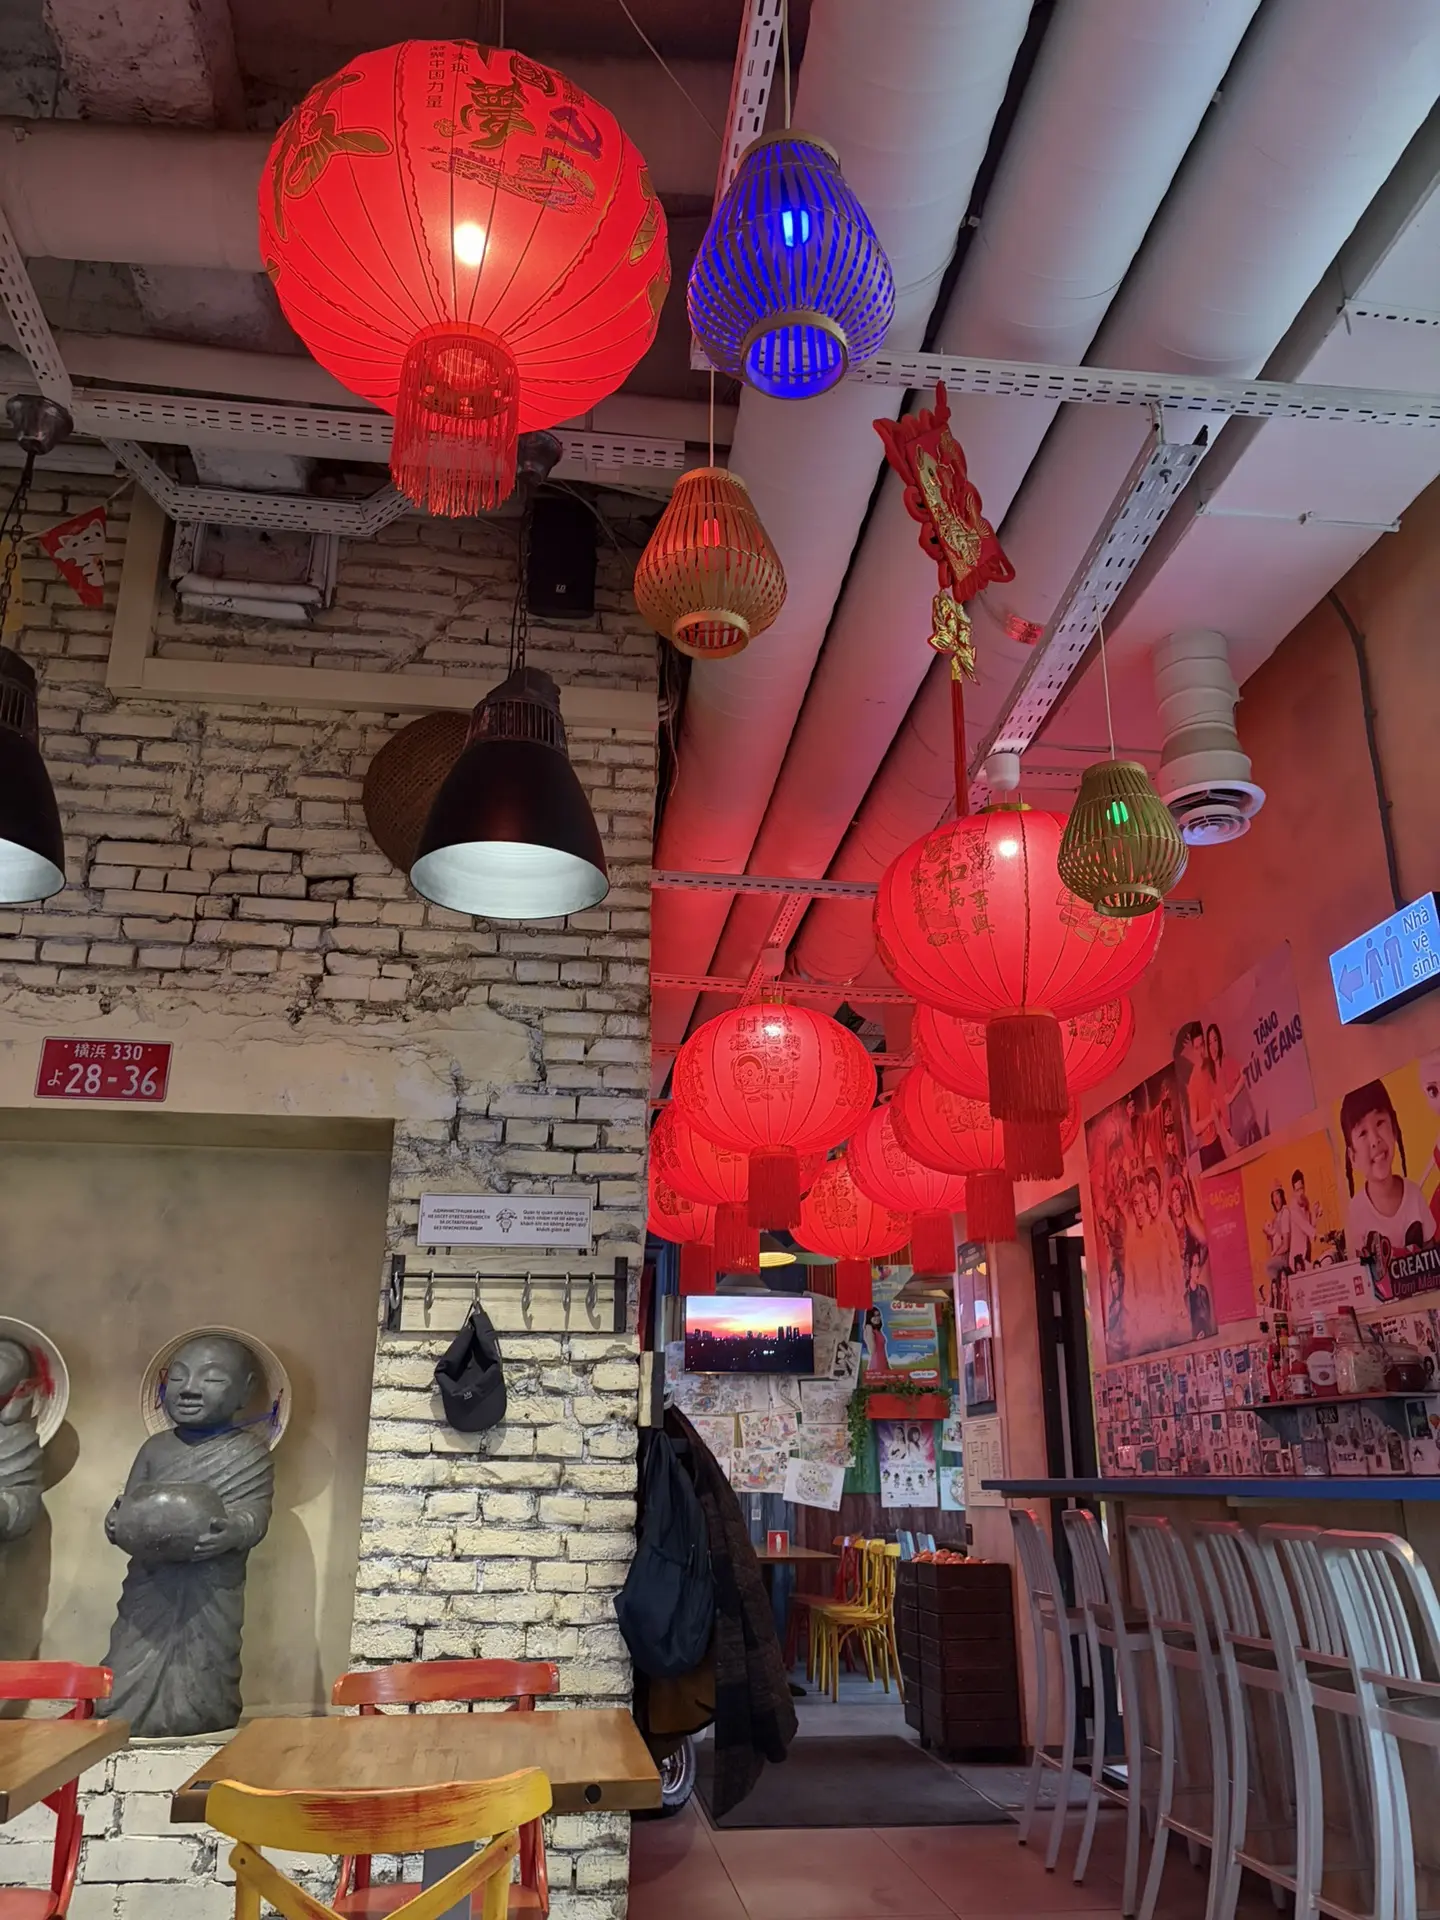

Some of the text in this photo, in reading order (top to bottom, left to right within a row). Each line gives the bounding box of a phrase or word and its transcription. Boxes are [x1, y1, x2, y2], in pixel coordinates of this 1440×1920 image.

[1402, 905, 1431, 935] Nhà
[1412, 930, 1430, 953] vệ
[1412, 950, 1440, 979] sinh
[111, 1043, 144, 1061] 330
[1263, 1013, 1304, 1072] JEANS
[47, 1062, 159, 1096] よ 28-36
